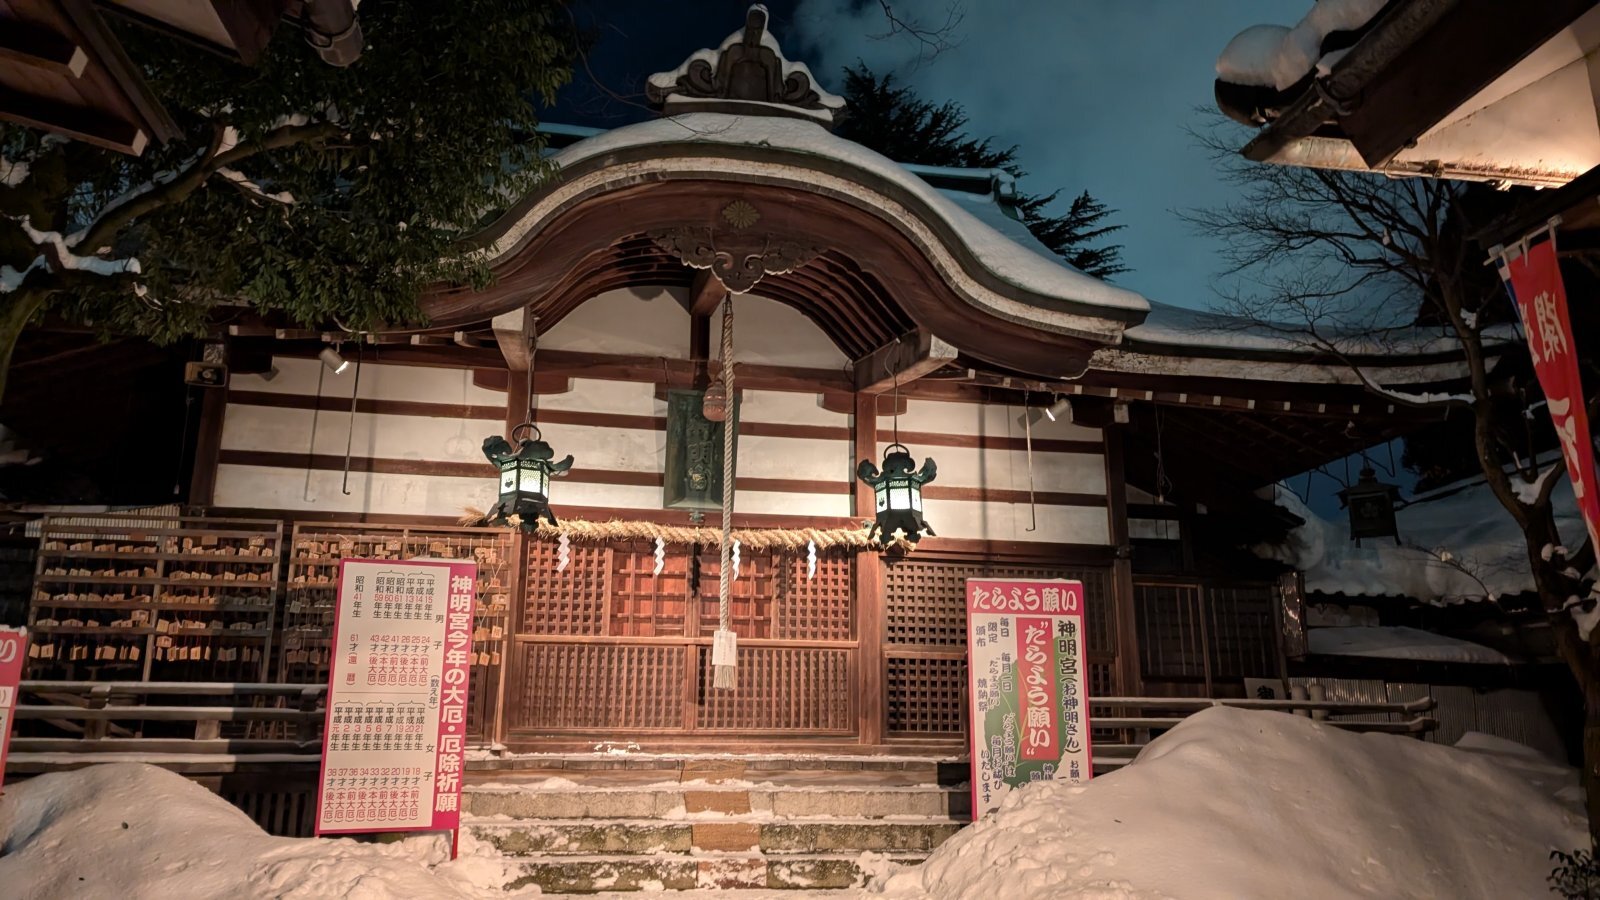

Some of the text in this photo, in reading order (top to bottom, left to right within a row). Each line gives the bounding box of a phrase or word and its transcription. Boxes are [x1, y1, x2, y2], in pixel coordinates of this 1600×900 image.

[972, 586, 1077, 612] たらよう願い
[434, 575, 472, 812] 神明宮今年の大厄・厄除祈願
